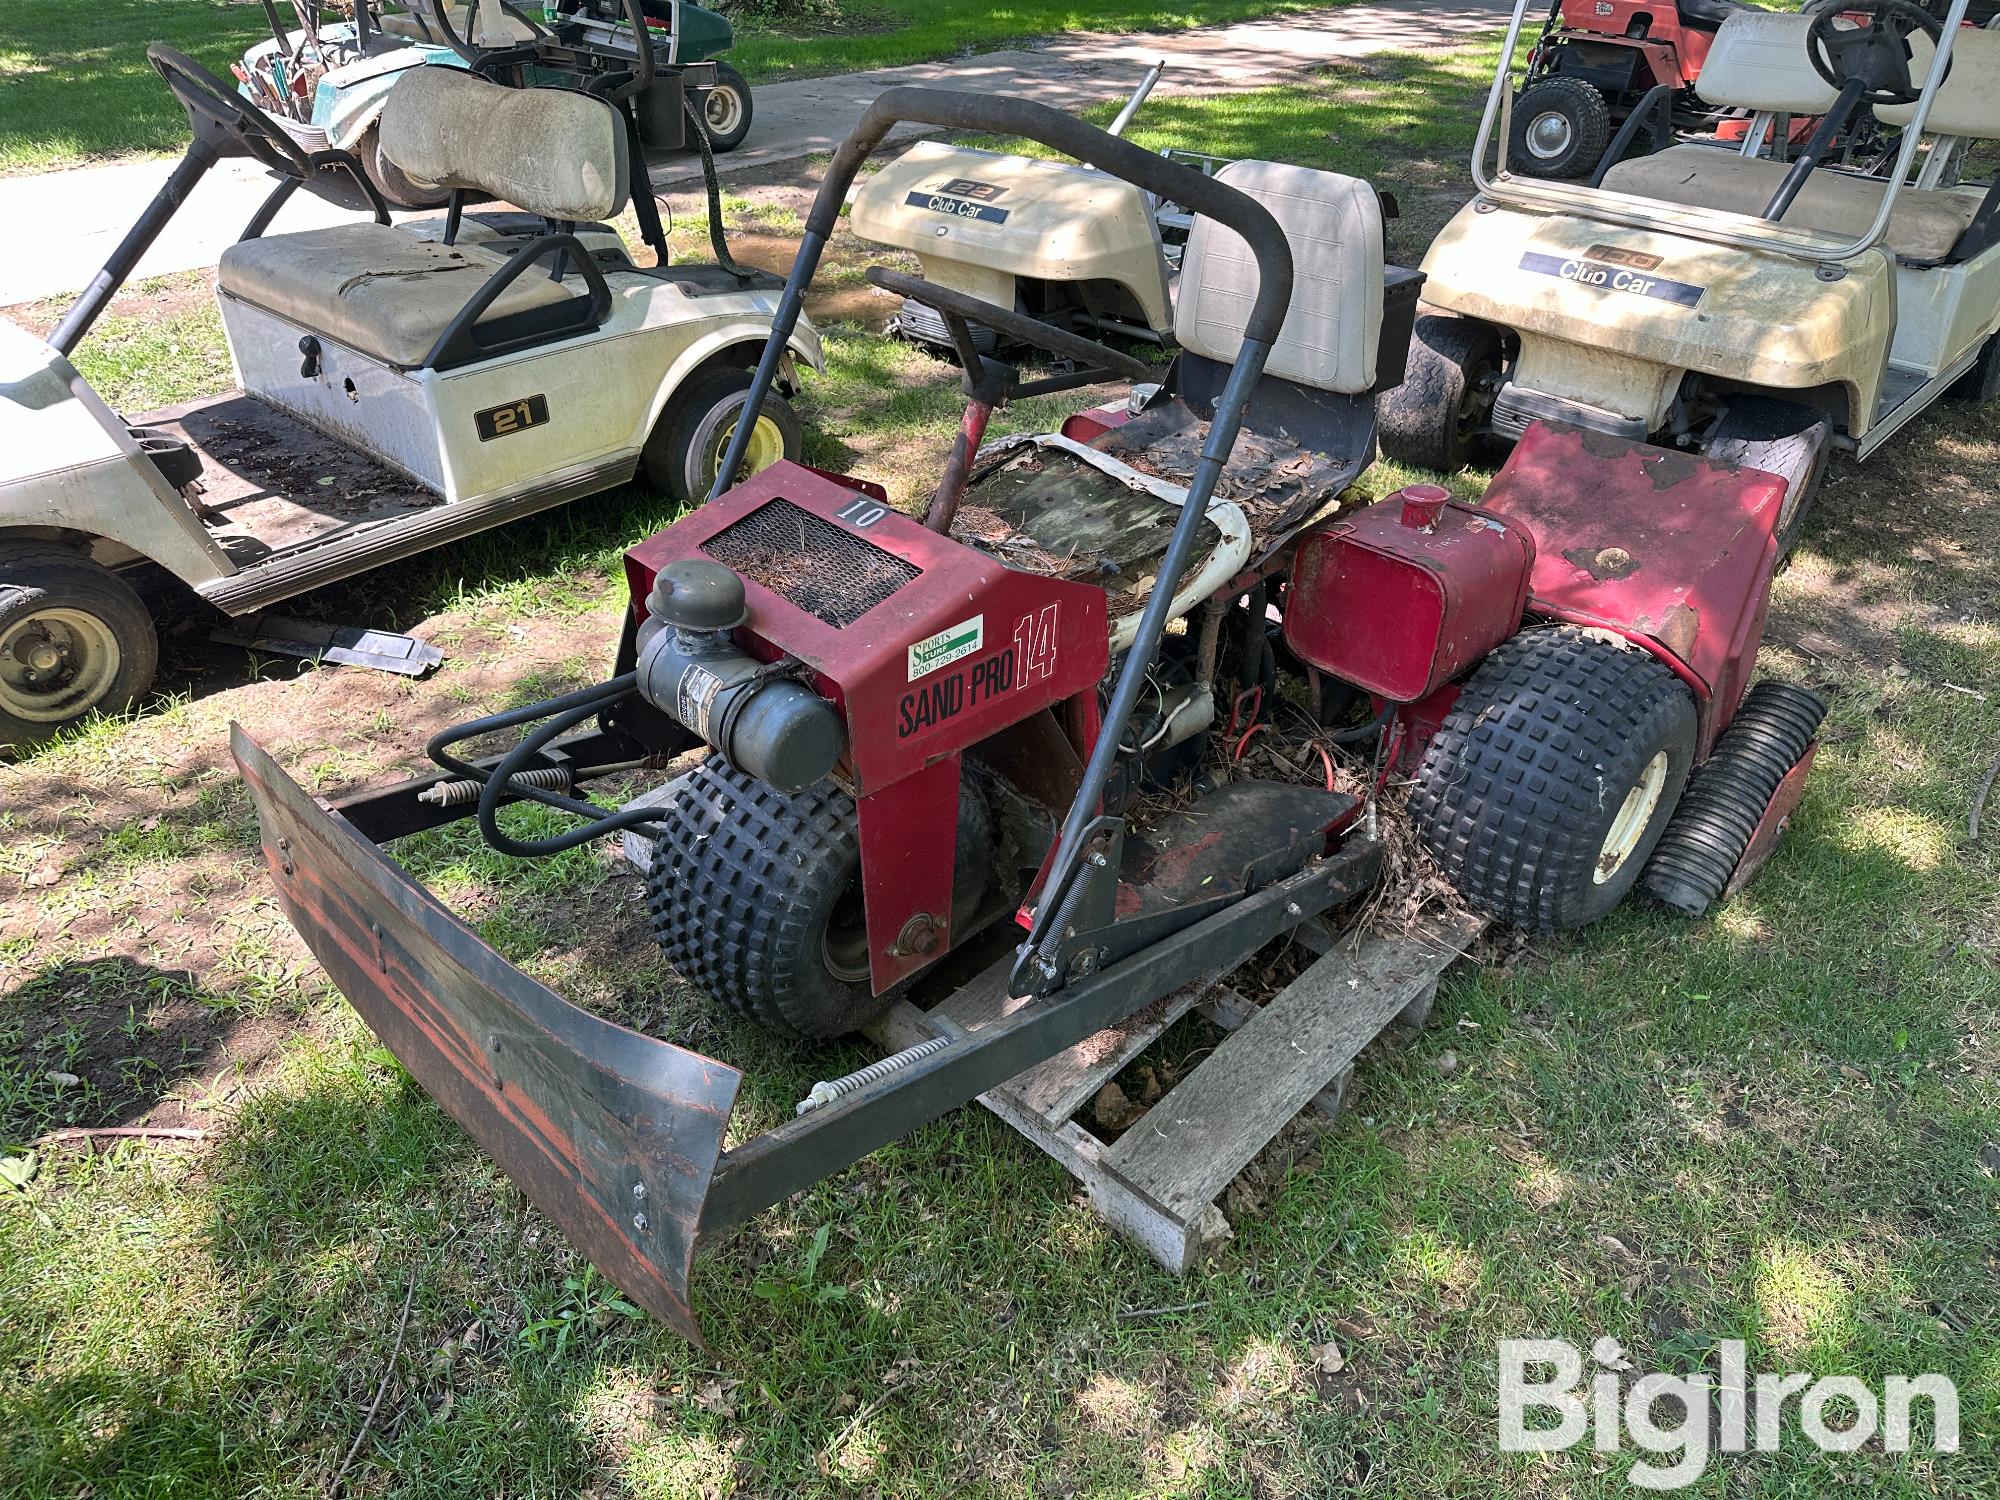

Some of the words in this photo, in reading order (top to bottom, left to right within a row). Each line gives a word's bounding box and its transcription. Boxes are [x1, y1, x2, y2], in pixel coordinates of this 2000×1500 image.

[949, 183, 994, 199] 22
[928, 196, 956, 213] Club
[957, 201, 983, 218] Car
[1612, 271, 1656, 295] Car
[493, 400, 533, 433] 21
[836, 500, 886, 527] 10
[912, 641, 978, 678] 800-729-2614
[924, 645, 948, 660] TURF
[899, 672, 964, 738] SAND
[971, 649, 1014, 706] PRO
[1014, 603, 1058, 691] 14
